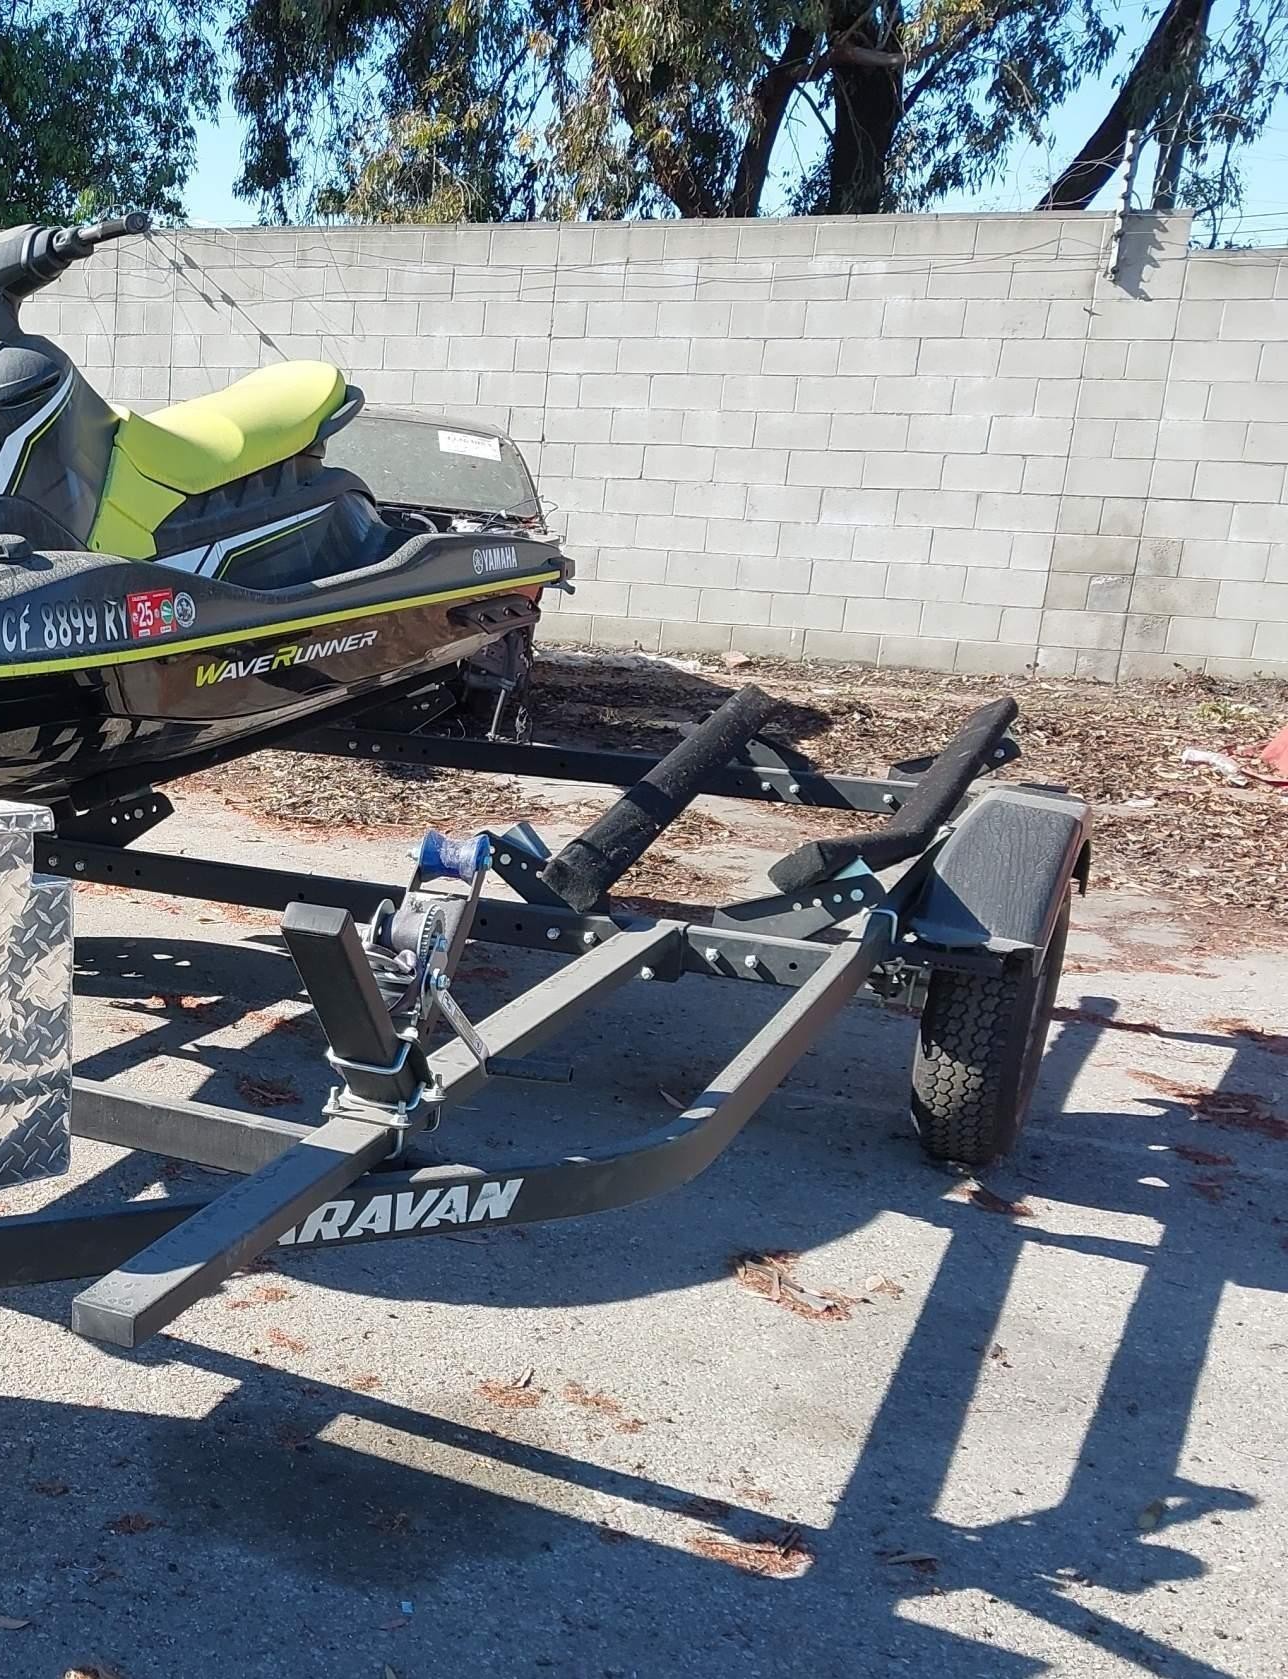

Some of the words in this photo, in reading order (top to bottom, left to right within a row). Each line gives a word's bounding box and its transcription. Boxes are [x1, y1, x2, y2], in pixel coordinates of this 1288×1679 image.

[482, 546, 518, 572] YAMAHA
[2, 602, 31, 653] CF
[40, 601, 98, 650] 8899
[137, 601, 154, 628] 25
[195, 630, 379, 688] WAVERUNNER
[278, 1178, 525, 1247] RAVAN
